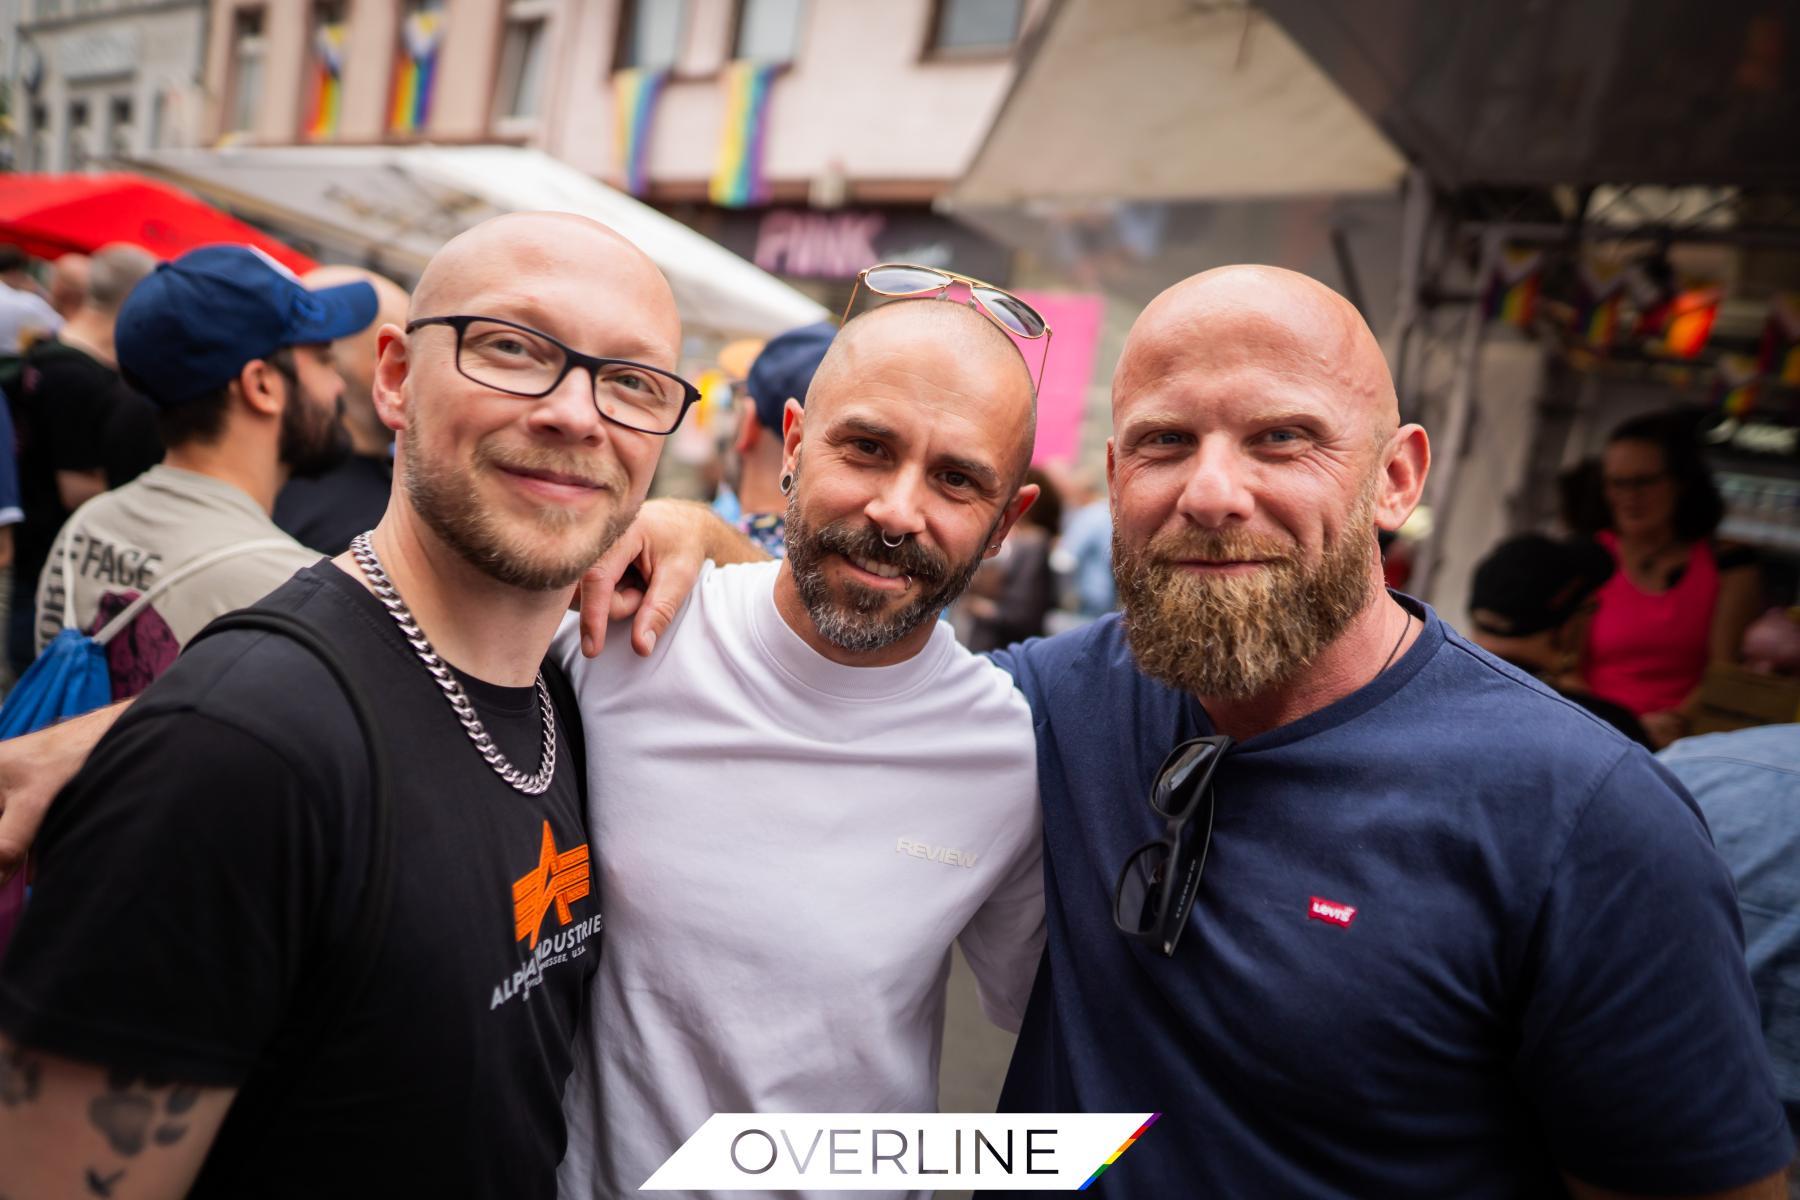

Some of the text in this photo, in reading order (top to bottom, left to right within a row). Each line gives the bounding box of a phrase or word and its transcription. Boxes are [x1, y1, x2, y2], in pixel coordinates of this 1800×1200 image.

[79, 536, 163, 592] FACE
[895, 837, 977, 869] REVIEW
[534, 914, 603, 961] NDUSTRIE
